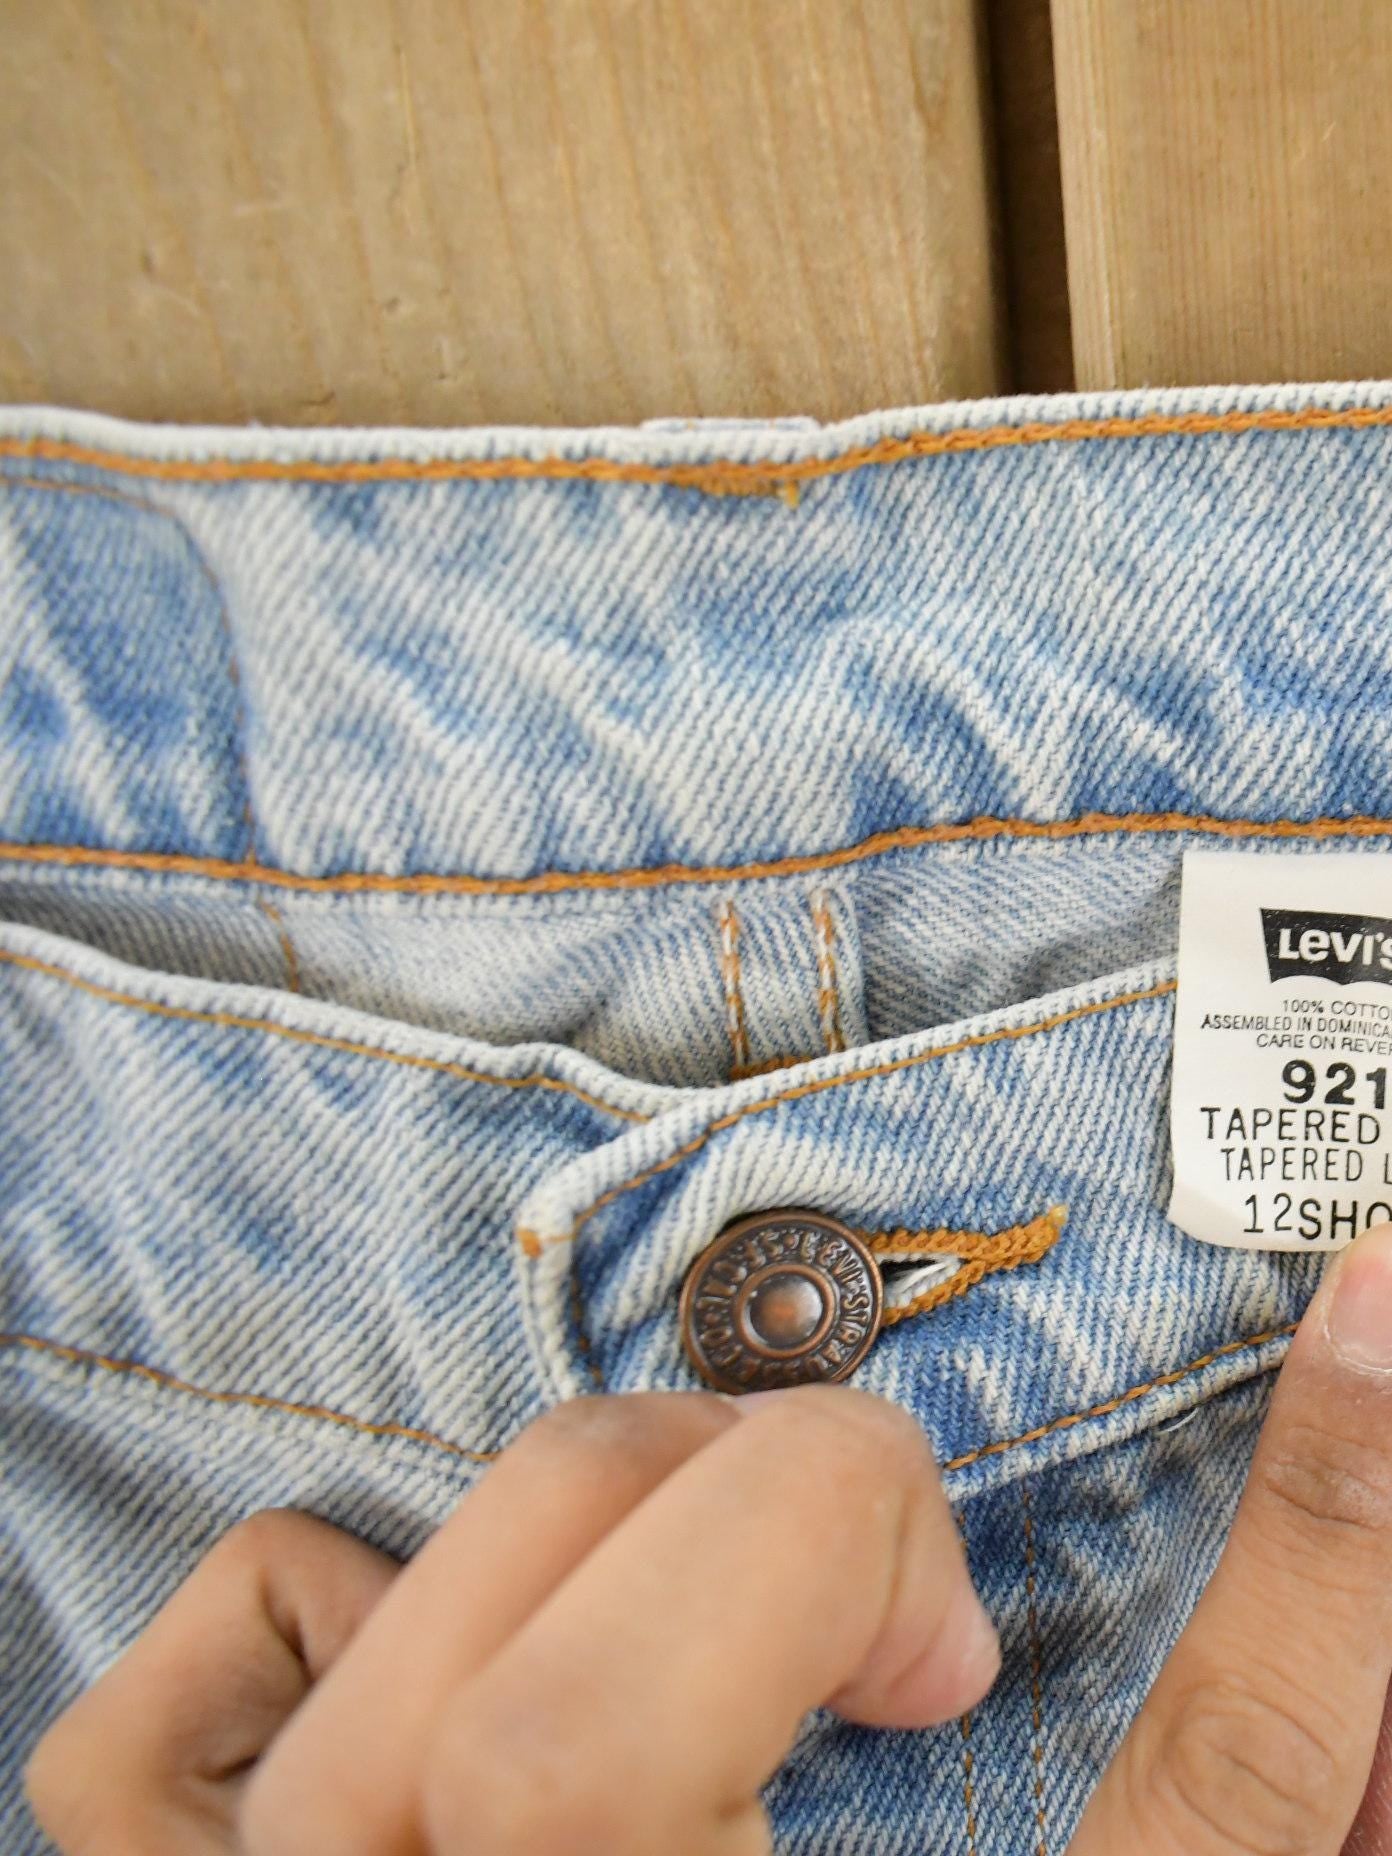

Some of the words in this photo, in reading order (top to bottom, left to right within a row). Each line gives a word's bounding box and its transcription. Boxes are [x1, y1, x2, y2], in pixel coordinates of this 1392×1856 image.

[1283, 1000, 1324, 1014] 100%
[1200, 1014, 1291, 1031] ASSEMBLED
[1297, 1016, 1312, 1031] IN
[1256, 1033, 1304, 1049] CARE
[1310, 1034, 1336, 1050] ON
[1282, 1059, 1387, 1110] 921
[1200, 1107, 1381, 1145] TAPERED
[1220, 1147, 1363, 1181] TAPERED
